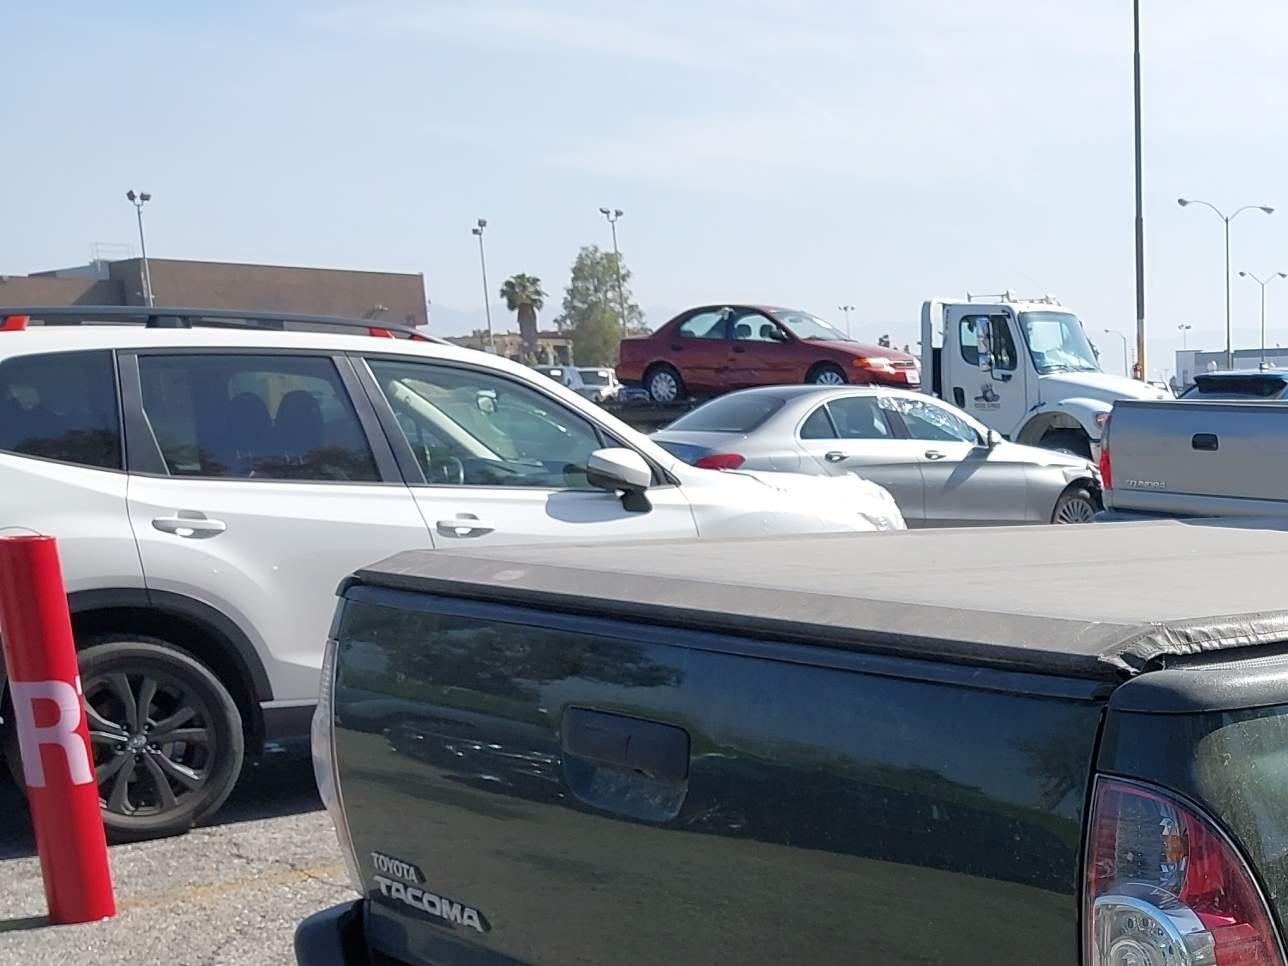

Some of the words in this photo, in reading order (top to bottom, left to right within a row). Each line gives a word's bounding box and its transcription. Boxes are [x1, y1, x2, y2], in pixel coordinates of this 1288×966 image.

[8, 676, 93, 787] R
[371, 852, 418, 884] TOYOTA
[374, 875, 484, 933] TACOMA
